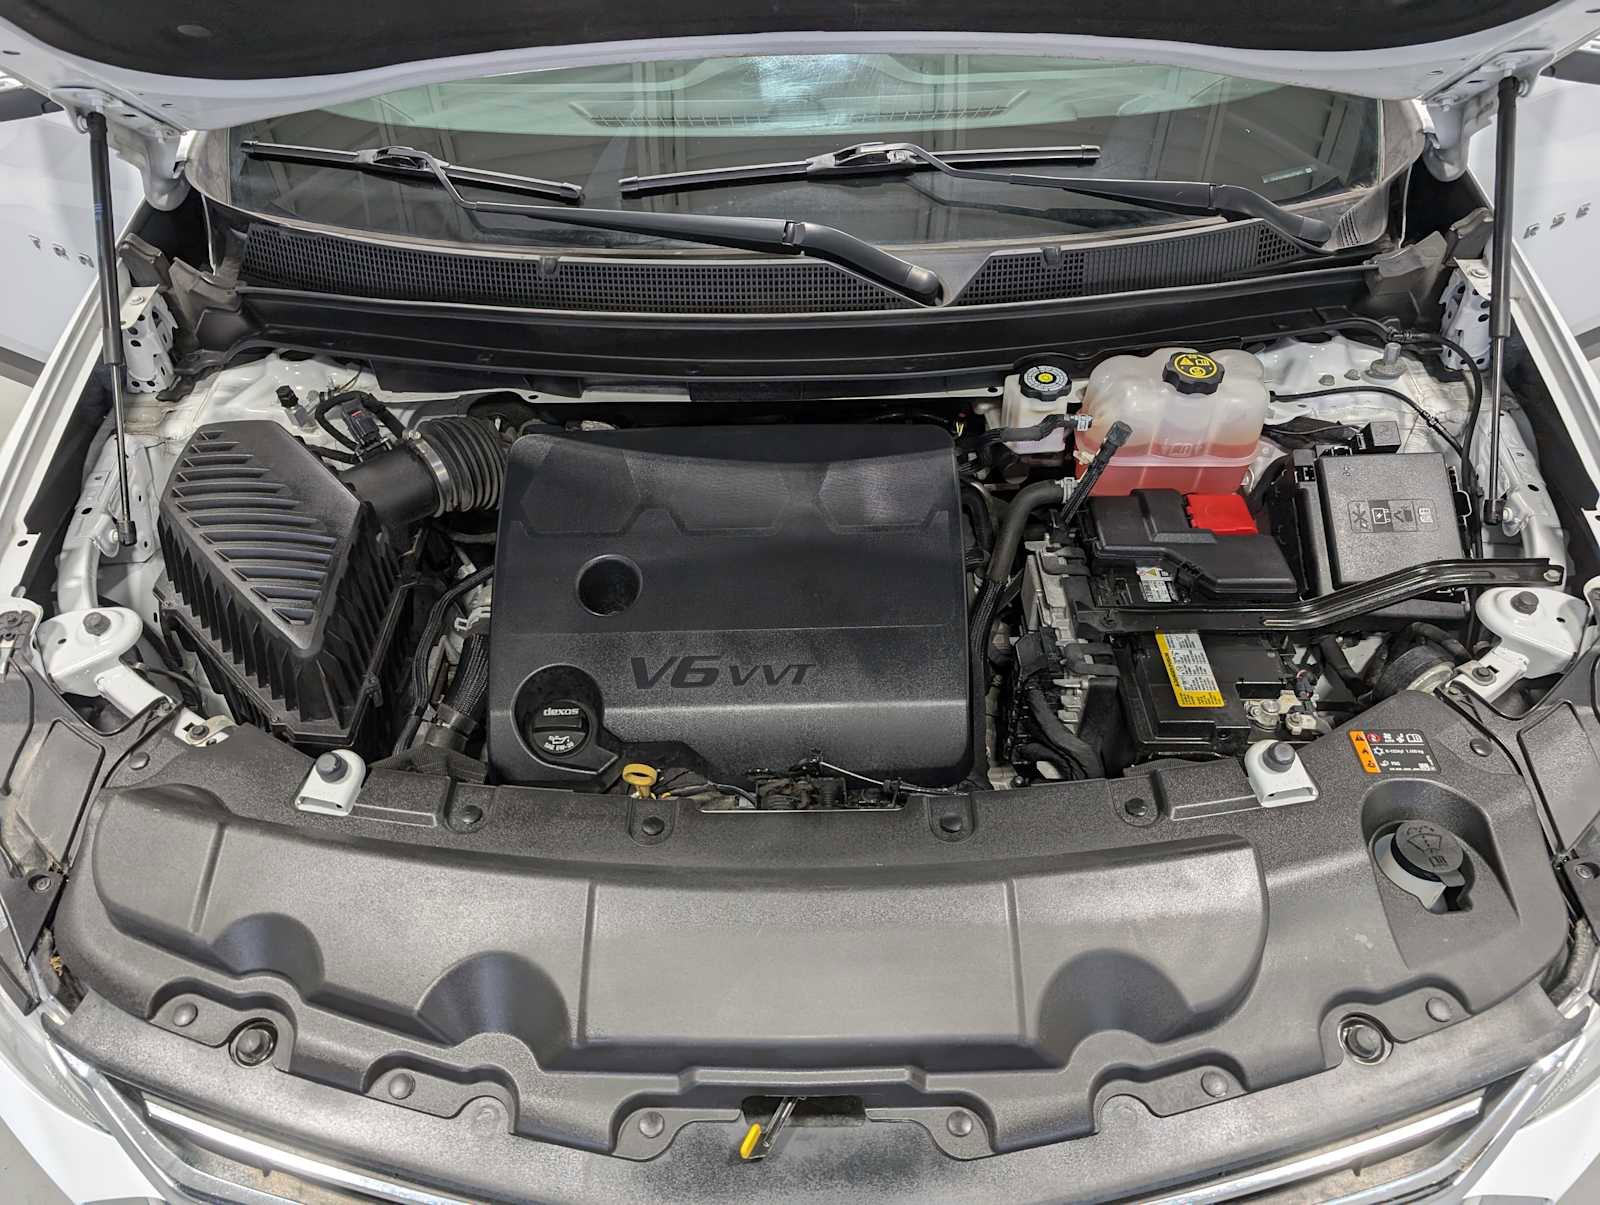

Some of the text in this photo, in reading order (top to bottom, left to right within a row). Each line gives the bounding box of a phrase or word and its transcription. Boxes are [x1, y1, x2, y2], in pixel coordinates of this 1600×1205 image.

[630, 655, 817, 690] V6 VVT
[543, 707, 580, 716] dexos
